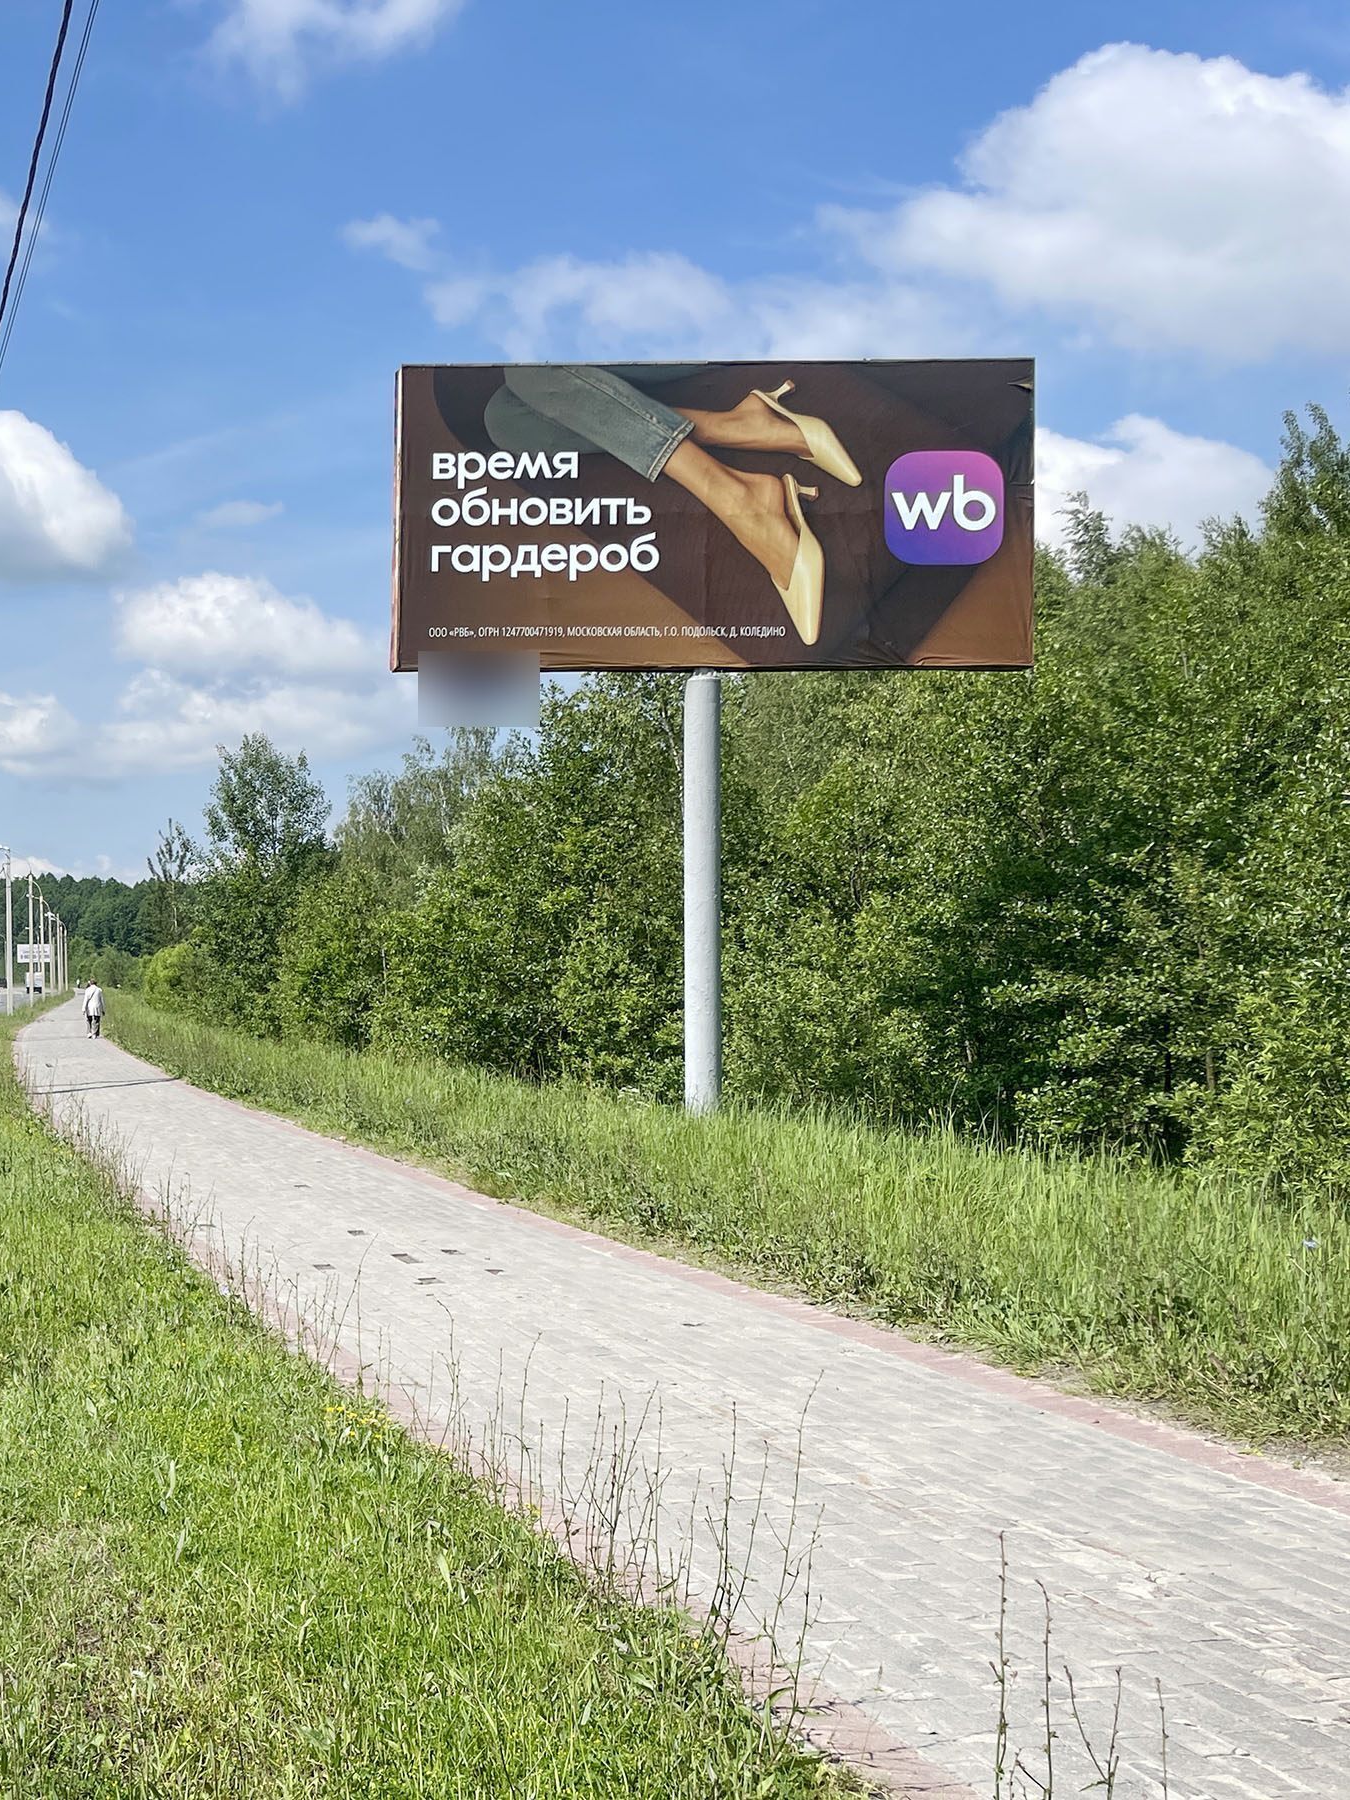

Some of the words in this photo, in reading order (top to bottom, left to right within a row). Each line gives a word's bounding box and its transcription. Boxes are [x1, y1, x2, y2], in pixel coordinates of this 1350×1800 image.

[432, 451, 579, 490] время
[431, 486, 652, 527] обновить
[891, 474, 996, 531] wb
[430, 531, 660, 582] гардероб
[428, 627, 447, 638] ООО
[478, 626, 499, 637] ОГРН
[502, 626, 565, 638] 1247700471919,
[567, 626, 622, 637] МОСКОВСКАЯ
[623, 626, 663, 638] ОБЛАСТЬ,
[664, 626, 679, 637] Г.О.
[681, 626, 728, 639] ПОДОЛЬСК,
[740, 626, 786, 638] КОЛЕДИНО
